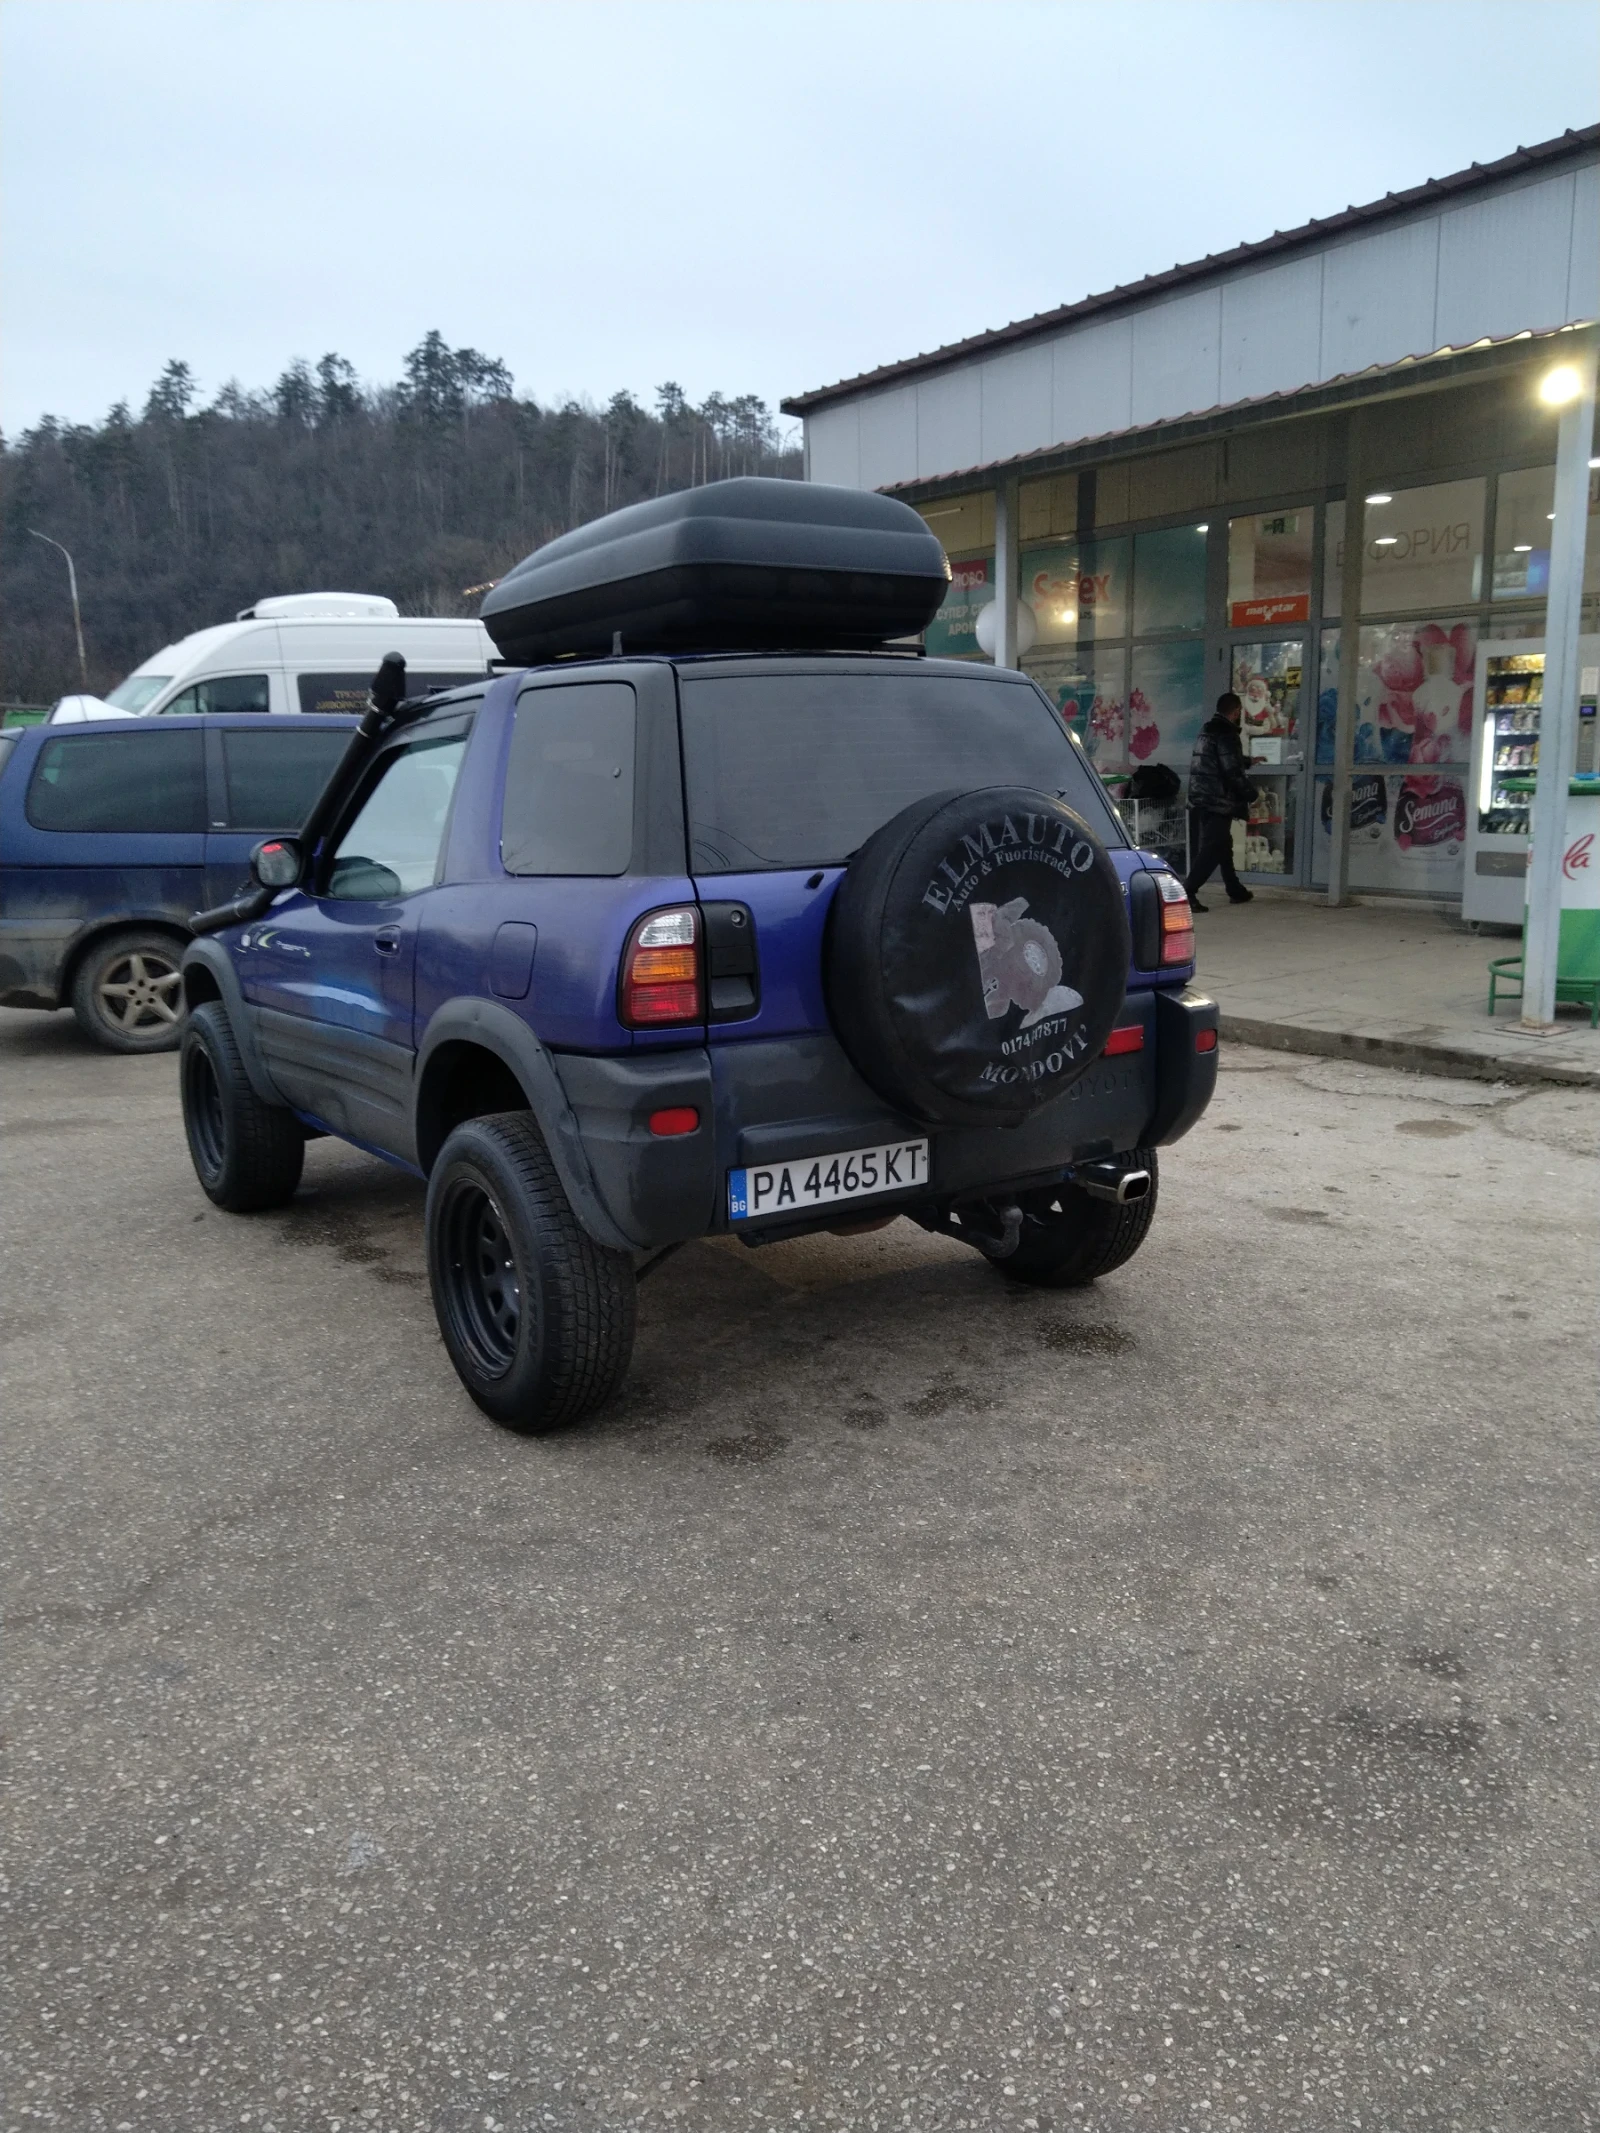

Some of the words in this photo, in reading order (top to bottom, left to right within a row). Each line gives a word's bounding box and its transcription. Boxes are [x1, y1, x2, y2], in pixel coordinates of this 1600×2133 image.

[1336, 522, 1470, 567] ЕФОРИЯ
[936, 605, 968, 620] СУПЕР
[1399, 796, 1458, 833] Semana
[922, 812, 1094, 916] ELMAUTO
[951, 873, 979, 912] Auto
[981, 859, 993, 876] &
[994, 845, 1073, 879] Fuoristrada
[1068, 1069, 1148, 1101] OYOTA
[754, 1167, 796, 1210] PA
[803, 1152, 879, 1199] 4465
[885, 1144, 923, 1186] KT
[731, 1200, 747, 1213] BG
